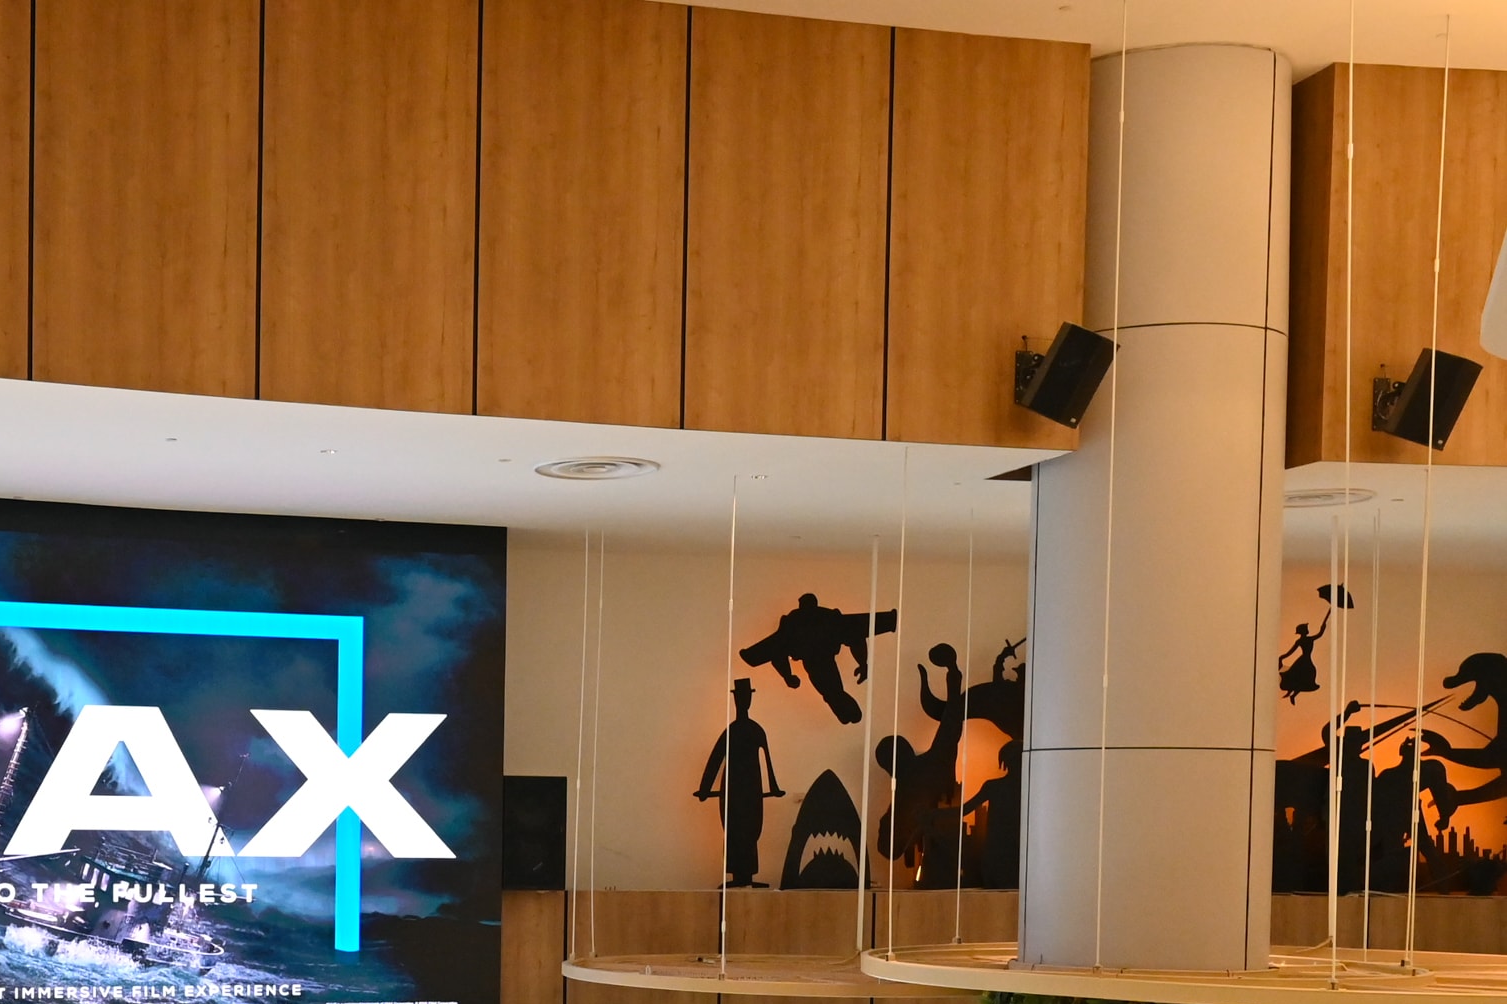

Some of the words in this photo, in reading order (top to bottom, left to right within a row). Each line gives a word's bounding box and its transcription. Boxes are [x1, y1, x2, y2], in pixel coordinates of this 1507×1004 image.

[31, 882, 96, 904] THE
[112, 882, 259, 904] FULLEST
[13, 985, 124, 1000] IMMERSIVE
[131, 984, 176, 998] FILM
[183, 983, 302, 998] EXPERIENCE
